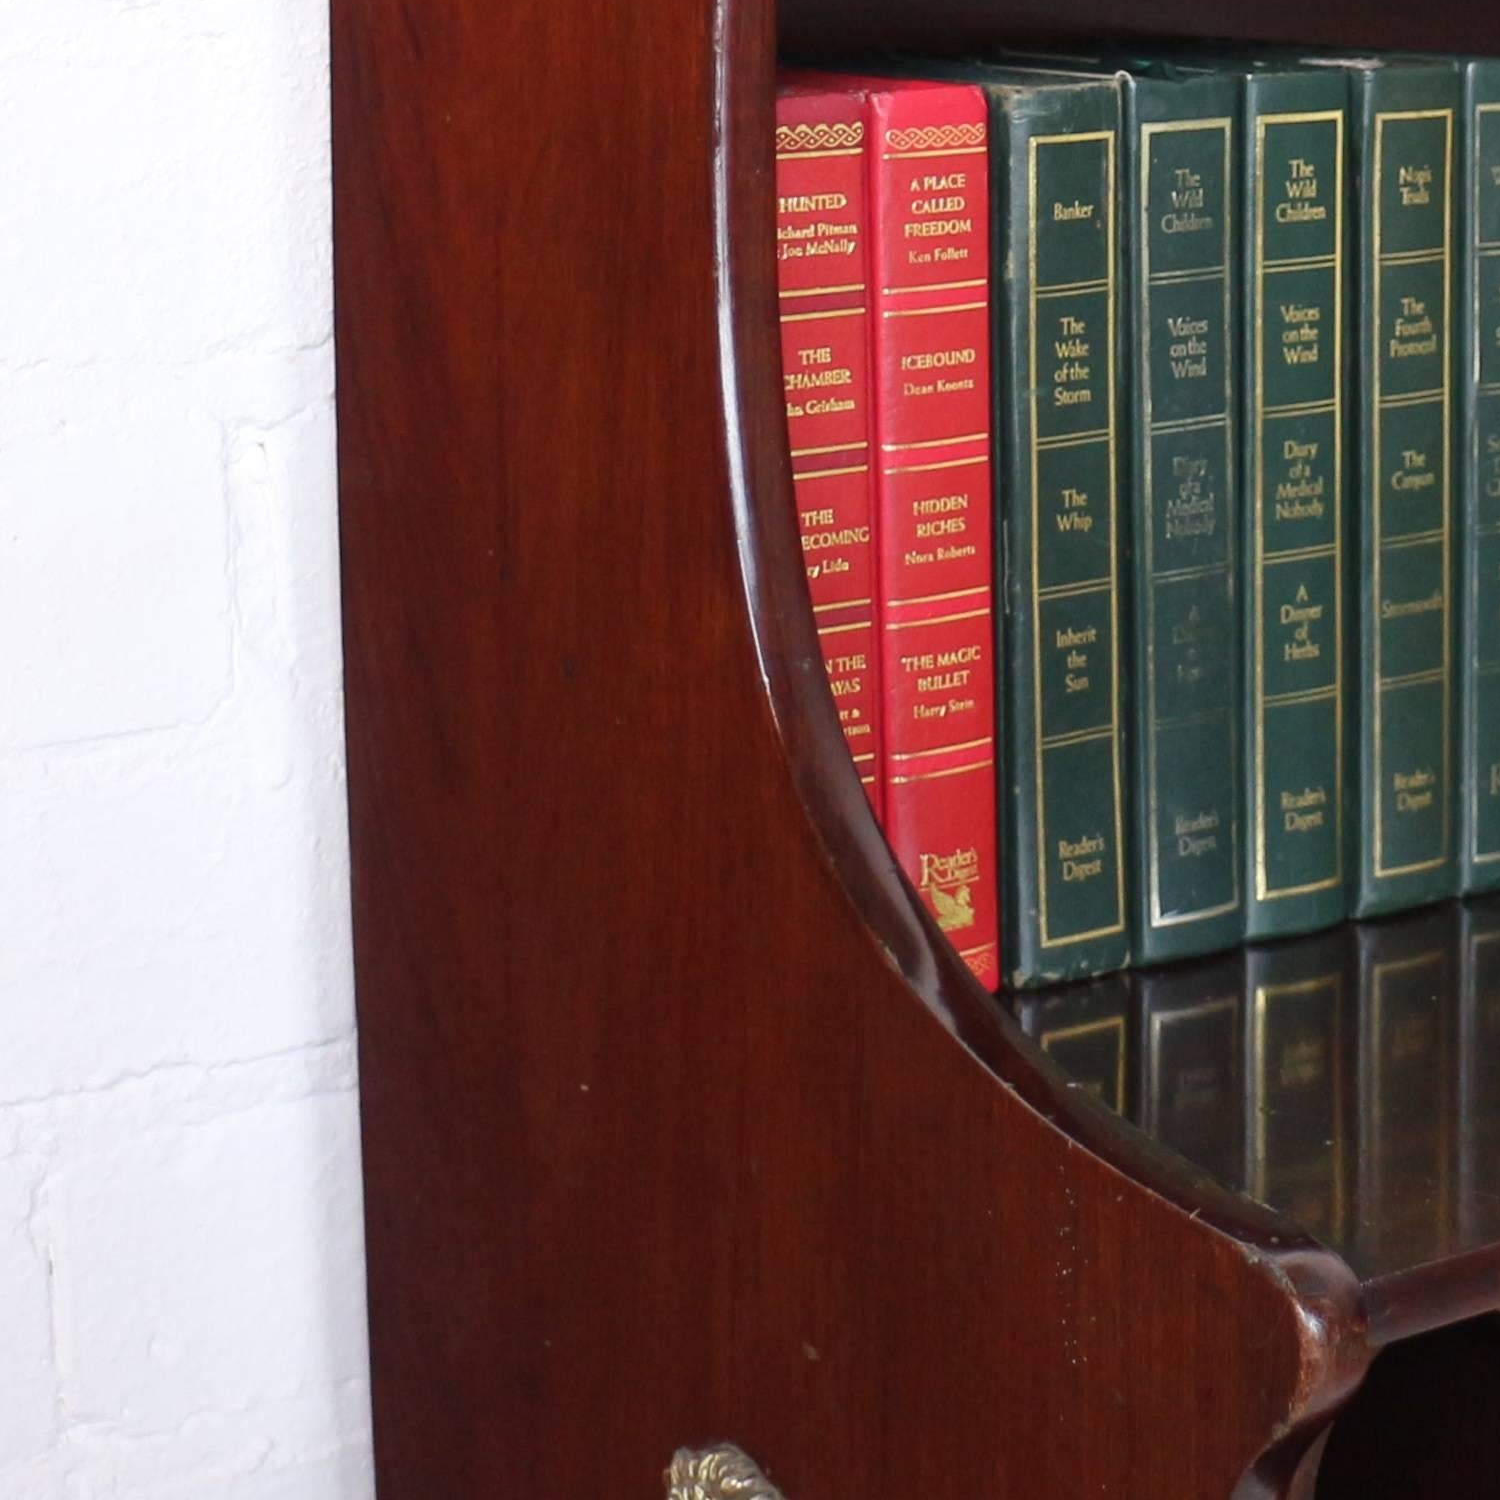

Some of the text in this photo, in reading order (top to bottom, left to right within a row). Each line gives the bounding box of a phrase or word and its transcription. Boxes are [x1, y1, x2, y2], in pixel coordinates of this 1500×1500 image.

[1288, 159, 1314, 178] The
[910, 173, 966, 192] A PLACE
[1175, 169, 1201, 188] The
[1285, 179, 1317, 199] Wild
[779, 193, 847, 213] HUNTED
[911, 196, 965, 215] CALLED
[1171, 189, 1203, 209] Wild
[1054, 201, 1094, 221] Banker
[1275, 202, 1326, 223] Children
[777, 224, 815, 240] ichard
[904, 219, 971, 238] FREEDOM
[1161, 214, 1213, 234] Children
[805, 238, 856, 257] McNally
[908, 248, 969, 264] Ken Follett
[1280, 304, 1320, 323] Voices
[1400, 297, 1425, 316] The
[1060, 317, 1085, 336] The
[1167, 318, 1209, 337] Voices
[1282, 325, 1318, 343] on the
[798, 347, 832, 366] THE
[1055, 340, 1089, 359] Wake
[1170, 339, 1207, 358] on the
[1283, 344, 1318, 366] Wind
[901, 349, 976, 370] ICEBOUND
[1171, 358, 1206, 380] Wind
[1054, 361, 1090, 384] of the
[903, 378, 974, 396] Dean Koontz
[1054, 387, 1091, 406] Storm
[805, 398, 856, 415] Grisham
[1402, 450, 1426, 468] The
[912, 494, 969, 516] HIDDEN
[1062, 489, 1088, 509] The
[801, 508, 834, 527] THE
[1056, 513, 1092, 533] Whip
[916, 517, 966, 538] RICHES
[801, 526, 870, 551] ECOMING
[904, 544, 976, 566] Nora Roberts
[1295, 585, 1308, 602] A
[1056, 626, 1097, 648] Inherit
[835, 654, 867, 673] THE
[901, 645, 981, 672] THE MAGIC
[1067, 651, 1087, 670] the
[917, 669, 971, 692] BULLET
[1065, 675, 1089, 693] Sun
[913, 697, 975, 719] Harry Stein
[1059, 833, 1104, 859] Reader's
[1063, 860, 1102, 881] Digest
